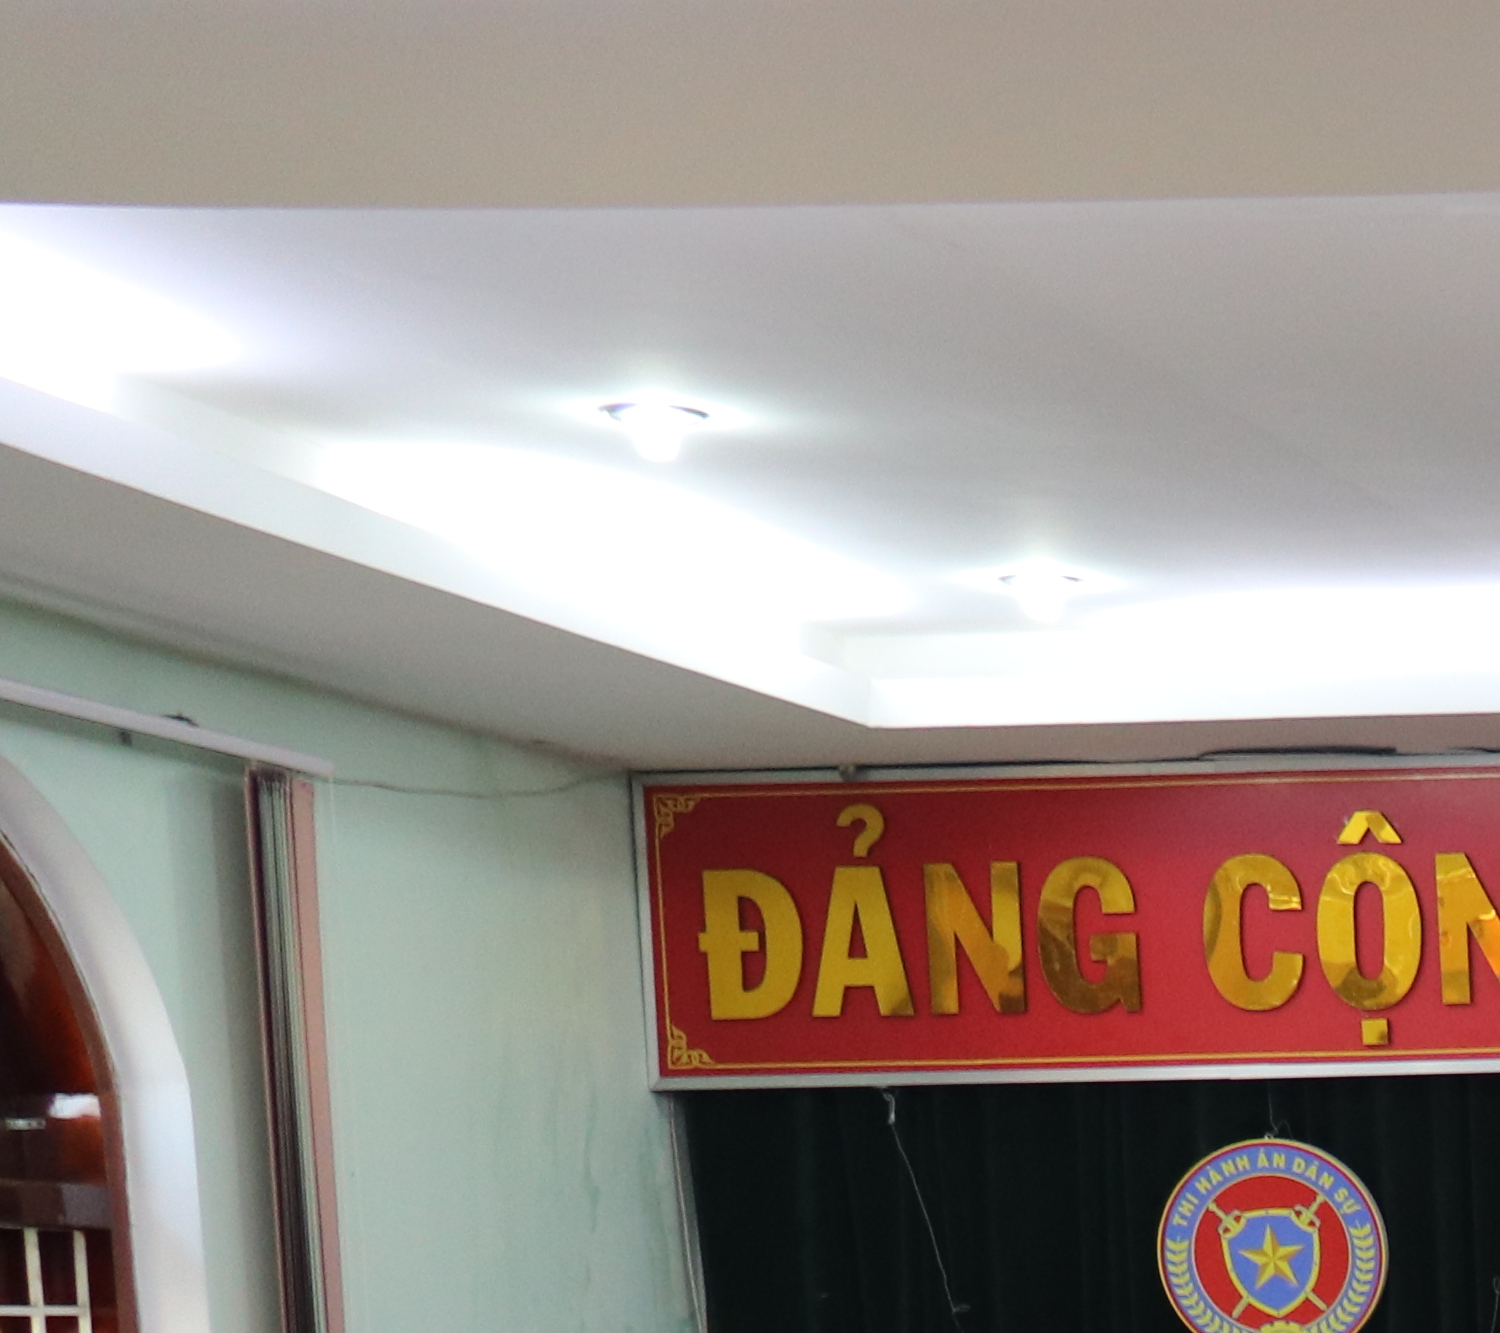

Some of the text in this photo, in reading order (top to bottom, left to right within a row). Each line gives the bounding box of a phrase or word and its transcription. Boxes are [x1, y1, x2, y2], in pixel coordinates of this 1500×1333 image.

[698, 803, 1144, 1021] ĐẢNG
[1172, 1147, 1362, 1227] THI HÀNH ÁN DÂN SỰ
